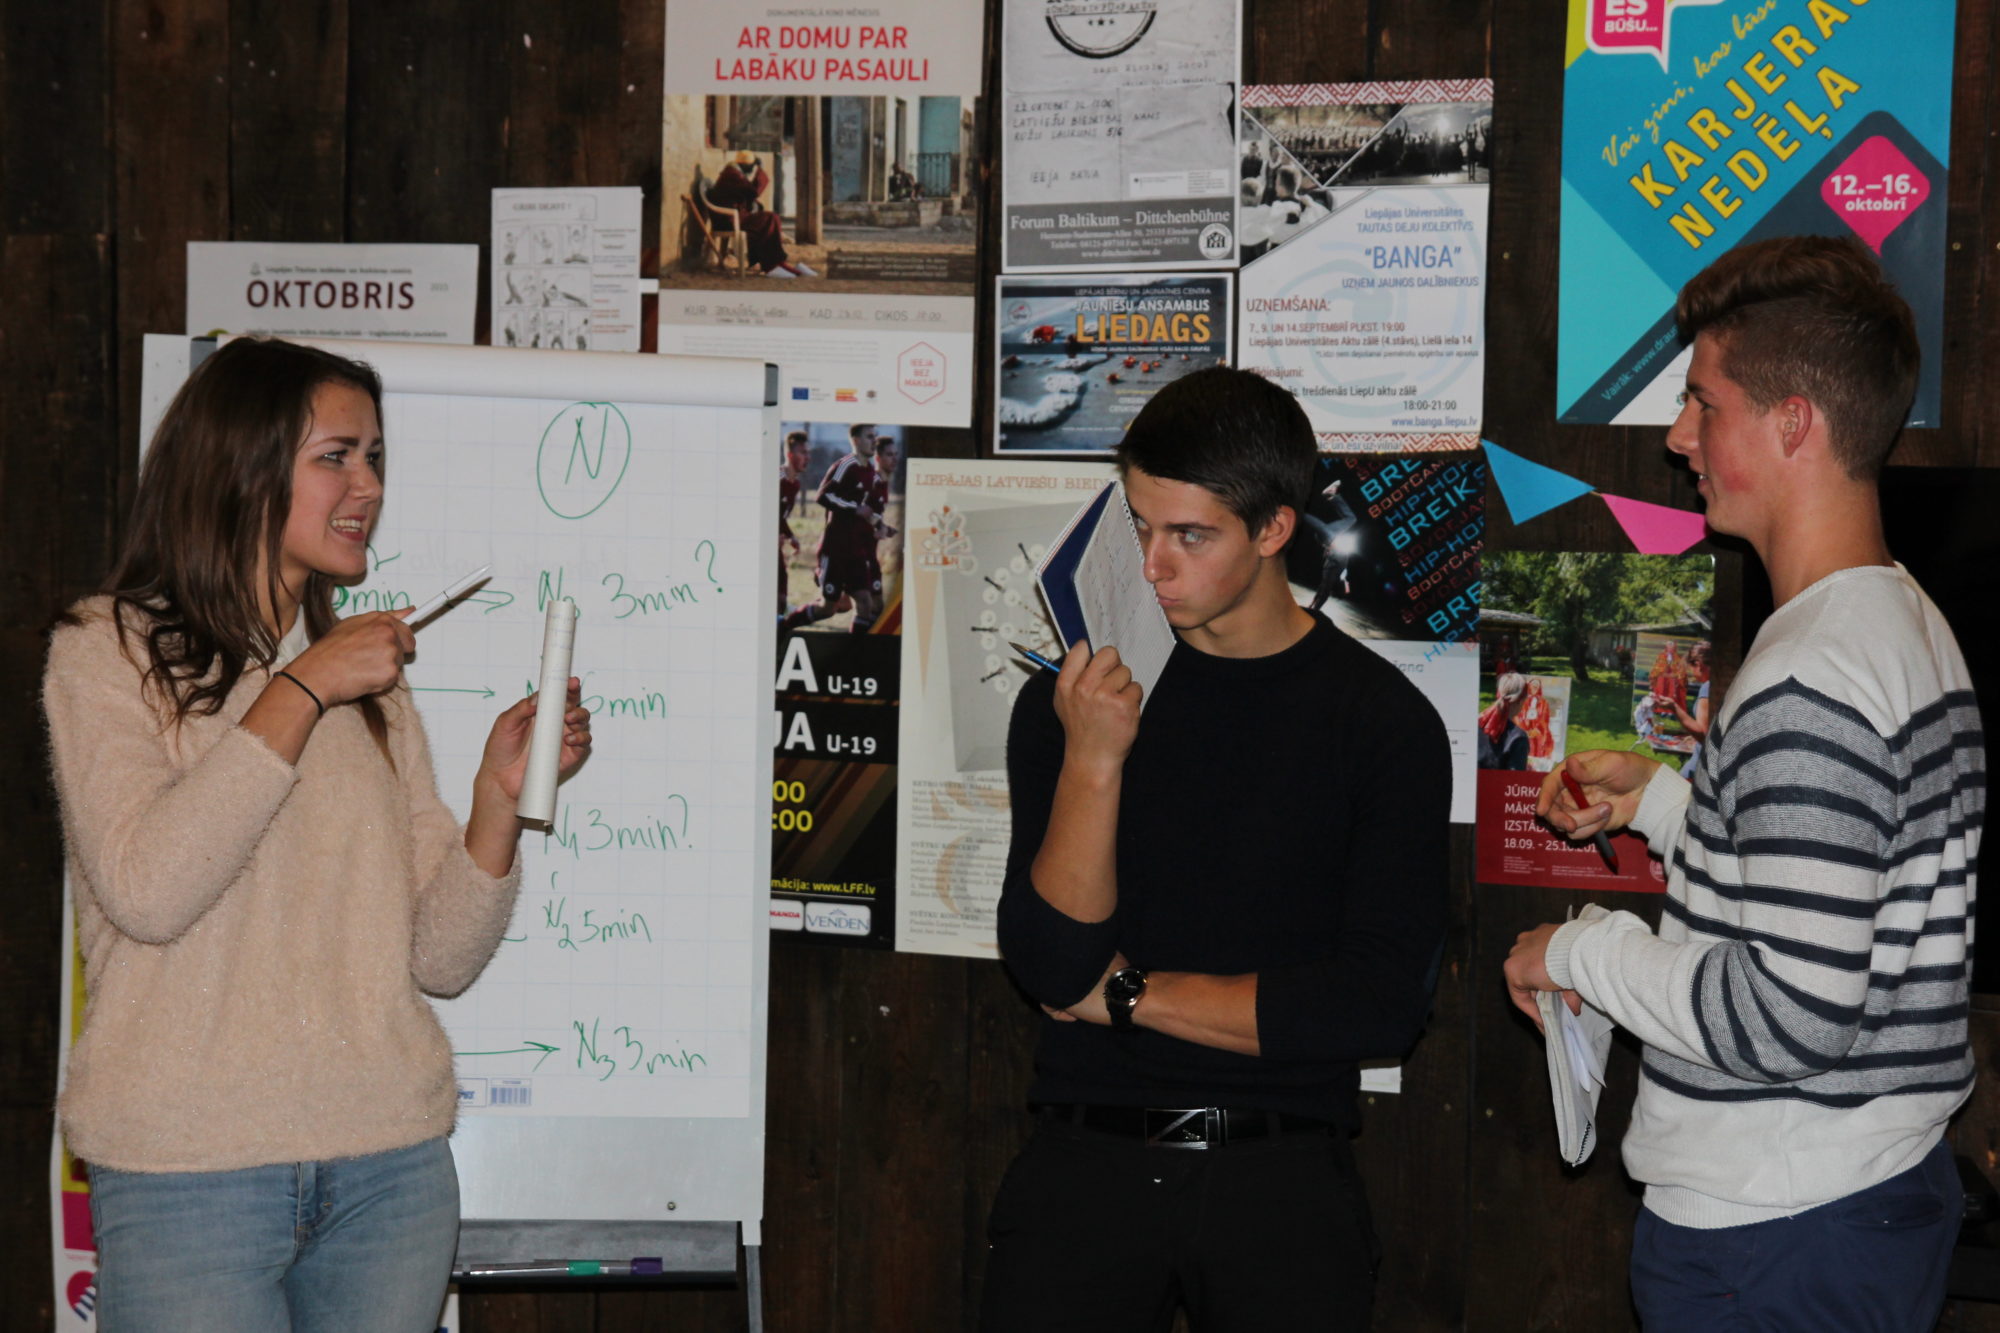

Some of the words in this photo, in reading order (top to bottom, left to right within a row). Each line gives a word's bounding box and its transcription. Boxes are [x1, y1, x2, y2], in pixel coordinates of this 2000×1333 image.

[737, 26, 770, 49] AR
[779, 26, 850, 49] DOMU
[859, 26, 907, 49] PAR
[715, 53, 815, 80] LABĀKU
[824, 58, 928, 81] PASAULI
[1628, 0, 1870, 209] KARJERA
[1667, 65, 1863, 250] NEDĒĻA
[1365, 208, 1402, 220] Liepājas
[1404, 206, 1464, 217] Universitātes
[1845, 196, 1907, 213] oktobrī
[1011, 214, 1055, 230] Forum
[1059, 212, 1120, 229] Baltikum
[1135, 208, 1231, 226] Dittchenbühne
[1357, 222, 1393, 233] TAUTAS
[1395, 221, 1420, 233] DEJU
[1422, 218, 1474, 232] KOLEKTĪVS
[1378, 276, 1415, 288] JAUNOS
[246, 279, 415, 310] OKTOBRIS
[684, 304, 706, 316] KUR
[809, 308, 832, 319] KAD
[1137, 298, 1211, 312] ANSAMBLIS
[1246, 296, 1331, 315] UZŅEMŠANA:
[1075, 312, 1212, 343] LIEDAGS
[1271, 323, 1285, 333] UN
[1381, 321, 1406, 333] 19:00
[1462, 335, 1473, 344] 14
[1377, 386, 1397, 396] aktu
[1403, 400, 1457, 411] 18:00-21:00
[564, 407, 608, 485] N
[916, 473, 982, 488] LIEPĀJAS
[987, 474, 1058, 490] LATVIEŠU
[1387, 476, 1478, 551] BREIK
[827, 674, 878, 696] U-19
[826, 733, 877, 755] U-19
[1504, 837, 1535, 850] 18.09.
[812, 882, 876, 895] www.LFF.lv
[806, 914, 869, 931] VENDEN
